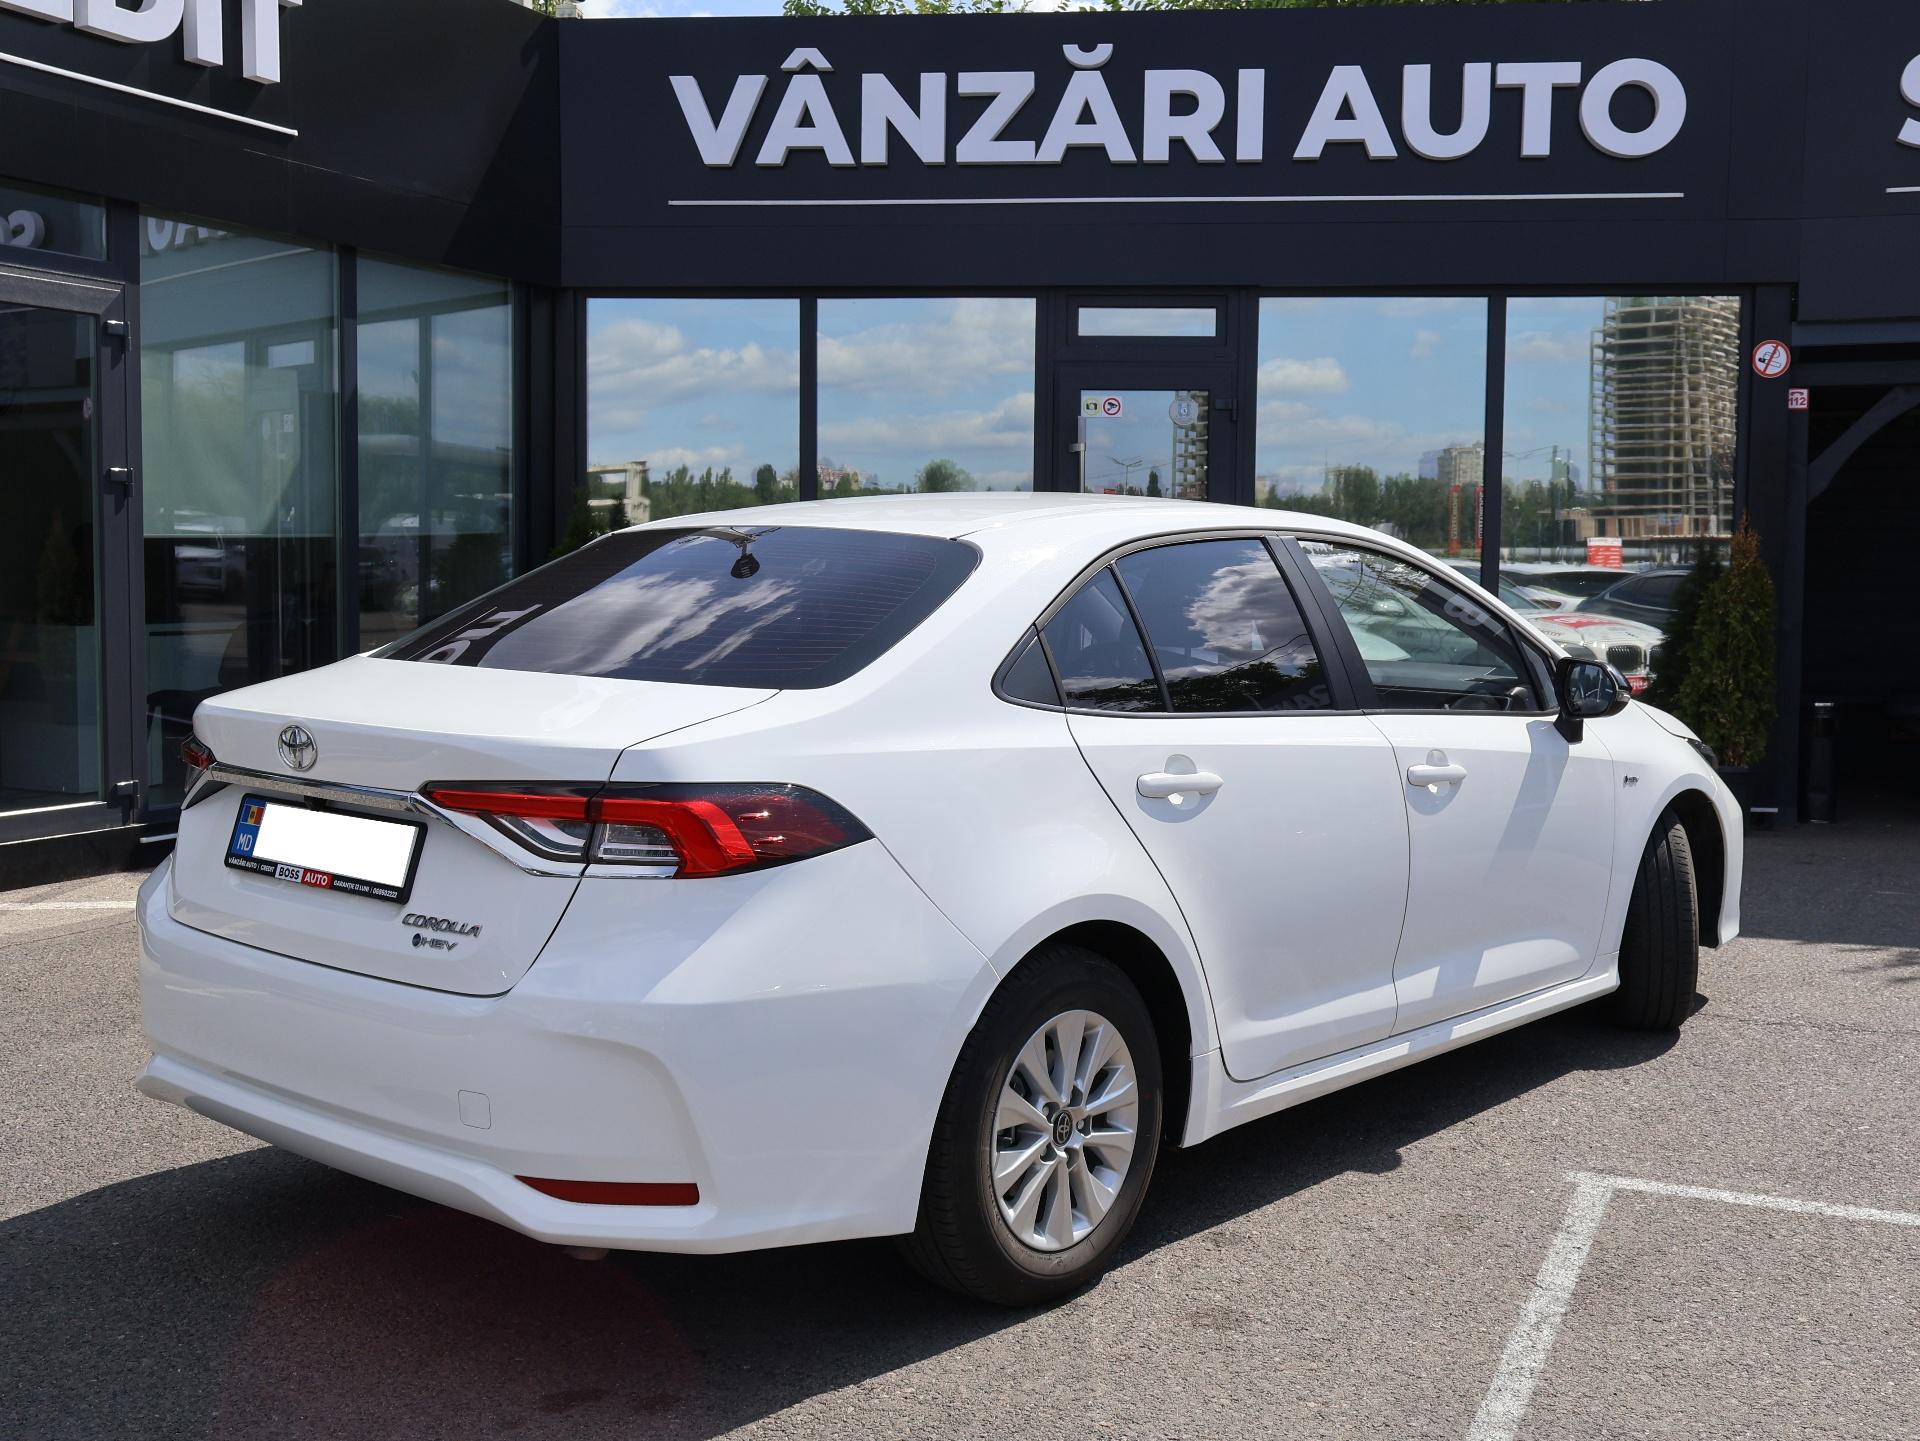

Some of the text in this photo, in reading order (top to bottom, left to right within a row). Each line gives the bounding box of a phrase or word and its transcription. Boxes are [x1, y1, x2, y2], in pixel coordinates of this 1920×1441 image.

[669, 43, 1687, 166] VÂNZĂRI AUTO
[1789, 397, 1806, 406] 112
[237, 833, 253, 851] MD
[279, 867, 300, 880] BOSS
[304, 872, 328, 886] AUTO
[402, 913, 483, 938] COROLLA
[421, 937, 458, 952] HEV
